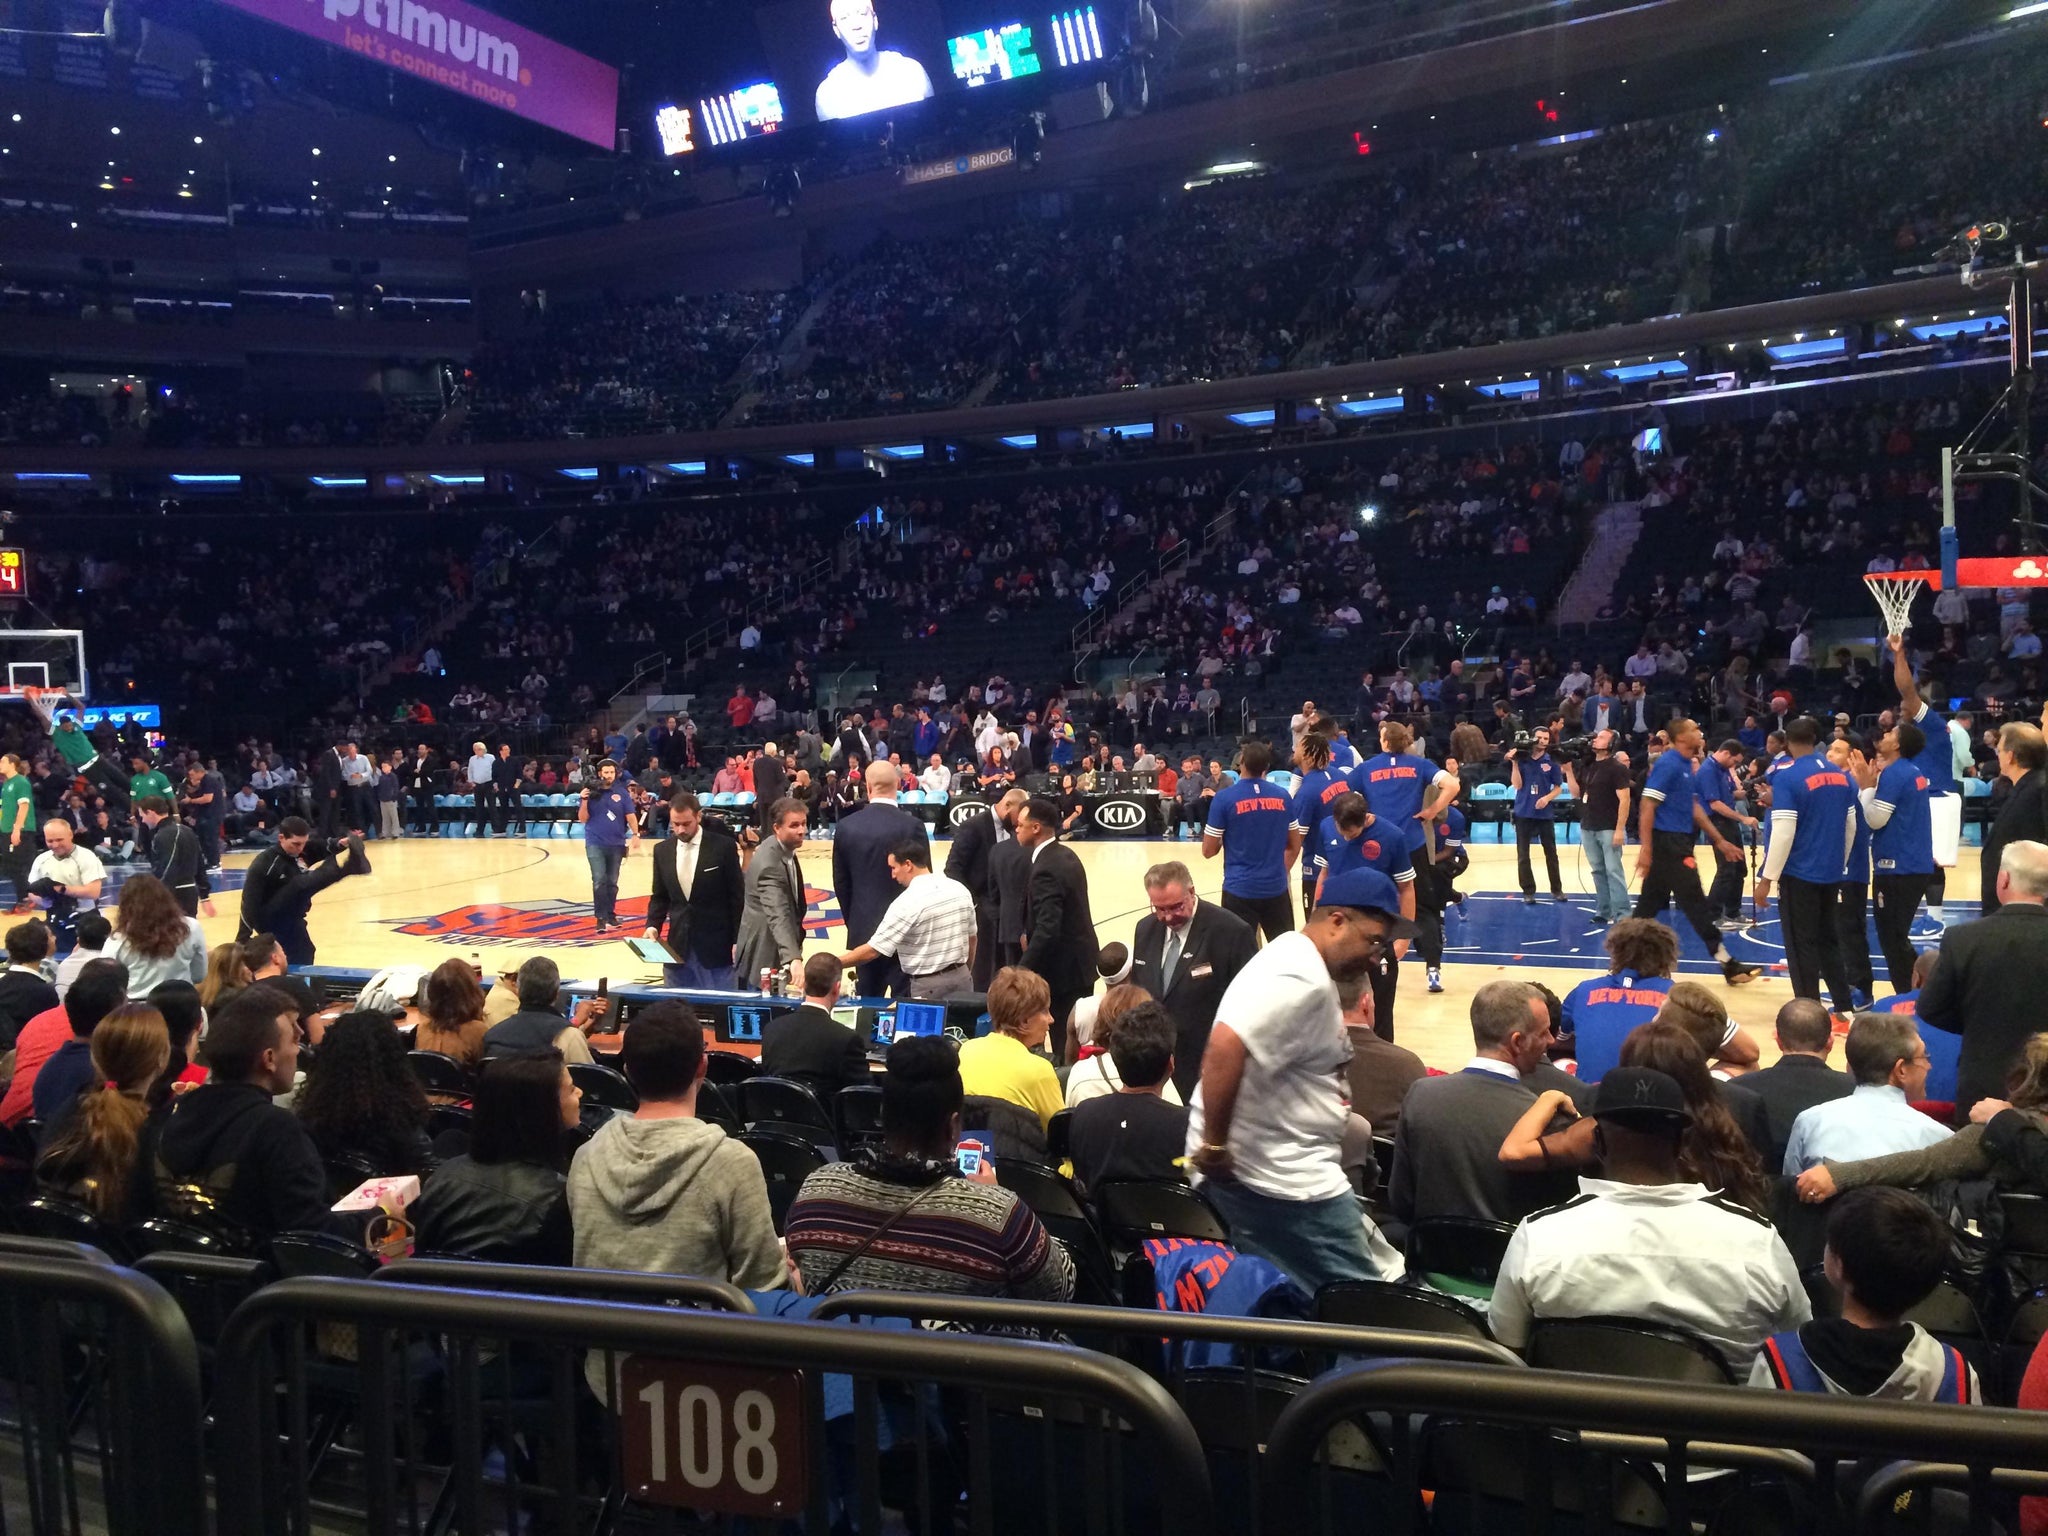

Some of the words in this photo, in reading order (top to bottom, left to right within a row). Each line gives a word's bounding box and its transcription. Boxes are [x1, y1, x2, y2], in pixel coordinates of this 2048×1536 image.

[345, 27, 386, 60] let's
[391, 50, 468, 92] connect
[471, 79, 517, 108] more
[1371, 768, 1391, 783] NEW
[1391, 766, 1417, 779] YORK
[1103, 807, 1137, 823] KIA
[1235, 799, 1259, 815] NEW
[1258, 797, 1286, 811] YORK
[1586, 987, 1624, 1006] NEW
[639, 1380, 779, 1495] 108
